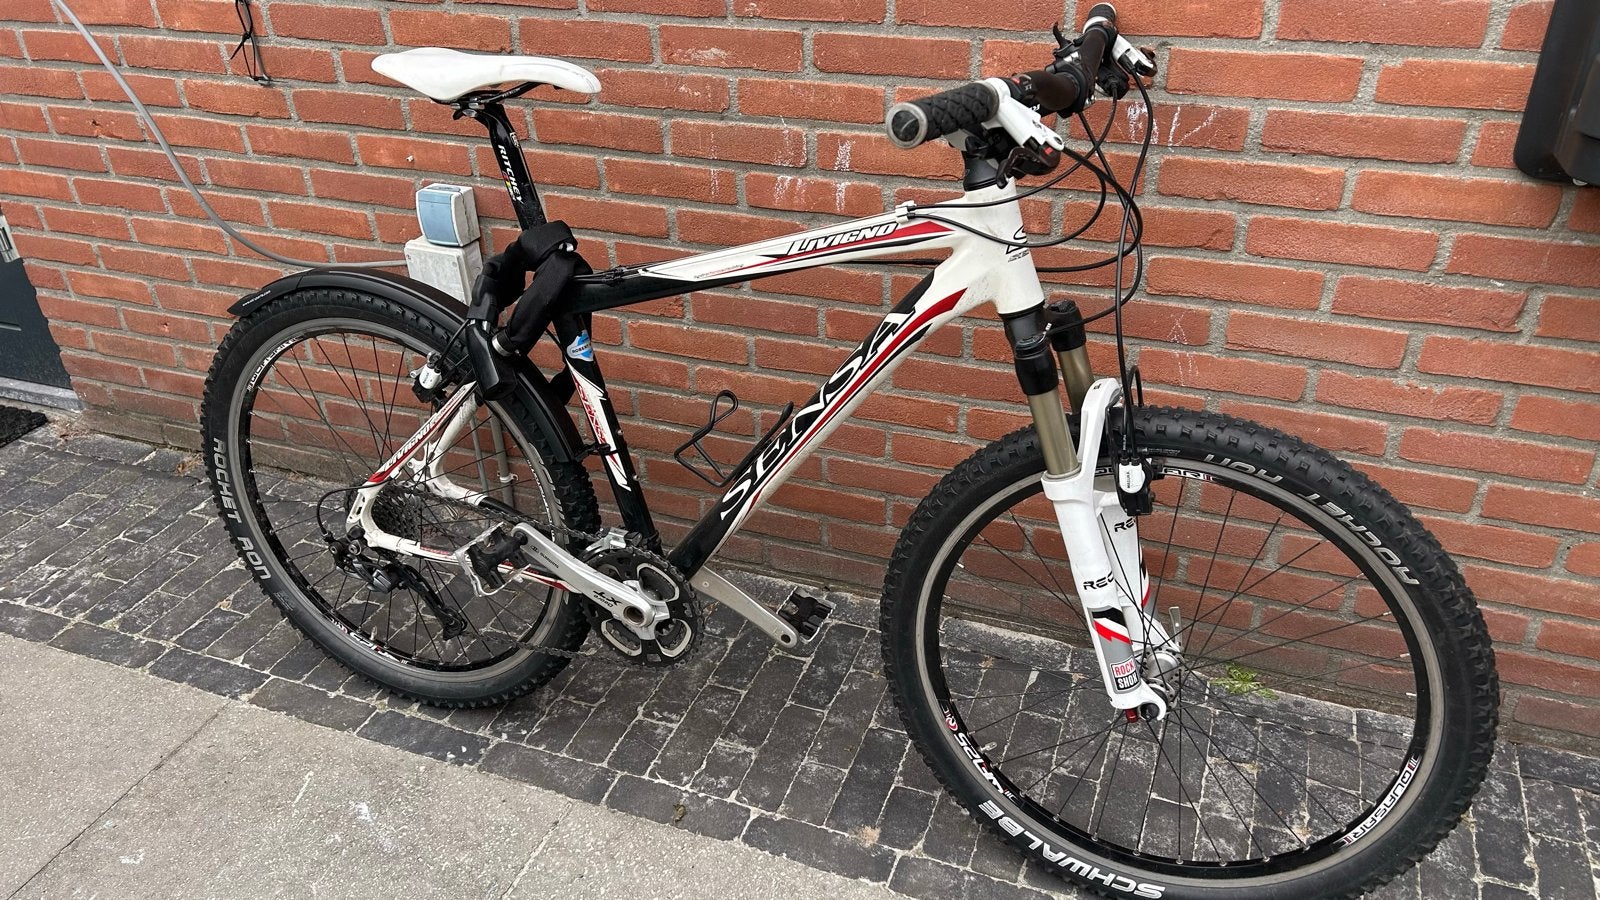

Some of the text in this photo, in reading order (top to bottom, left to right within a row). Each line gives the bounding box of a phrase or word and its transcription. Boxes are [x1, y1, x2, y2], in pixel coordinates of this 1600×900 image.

[497, 144, 523, 203] RITCHEY
[784, 222, 898, 257] LIVIGNO
[719, 309, 916, 521] SENSA
[213, 437, 272, 581] ROCKET RON
[1113, 516, 1137, 533] RE
[1297, 492, 1420, 586] ROCKET
[1114, 660, 1136, 677] ROCK
[1116, 672, 1140, 689] SHOX
[1351, 768, 1415, 840] QUASAR
[978, 799, 1166, 899] SCHWALBE
